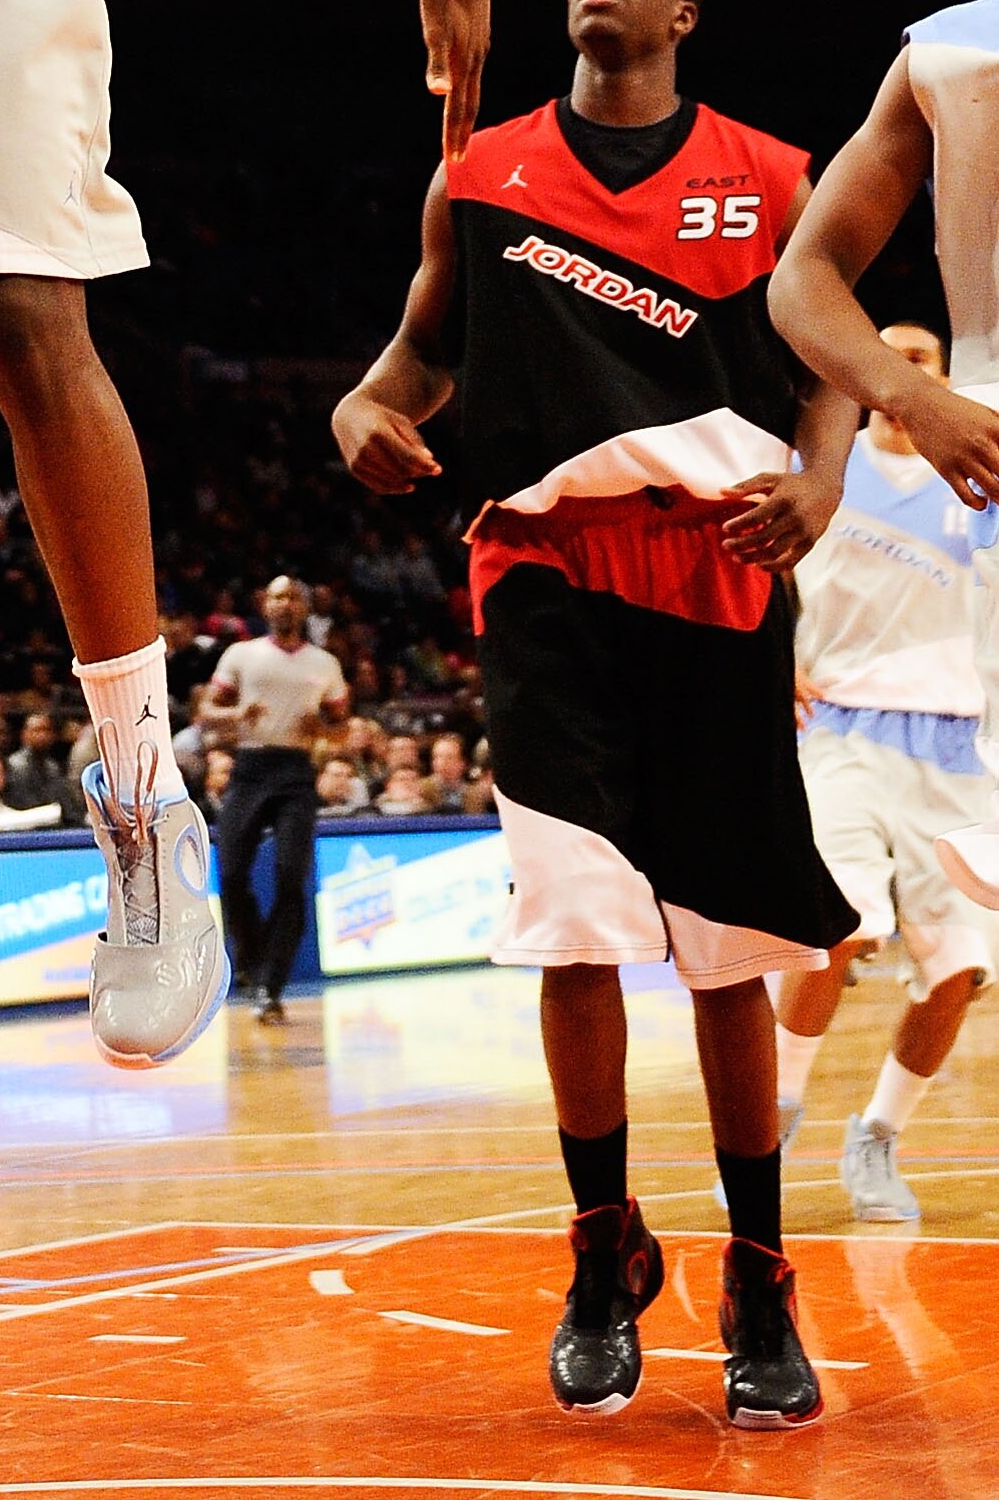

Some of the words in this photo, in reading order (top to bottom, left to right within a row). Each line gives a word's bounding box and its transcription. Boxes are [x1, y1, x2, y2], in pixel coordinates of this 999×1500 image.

[686, 174, 750, 189] EAST
[676, 195, 761, 240] 35
[503, 235, 699, 338] JORDAN
